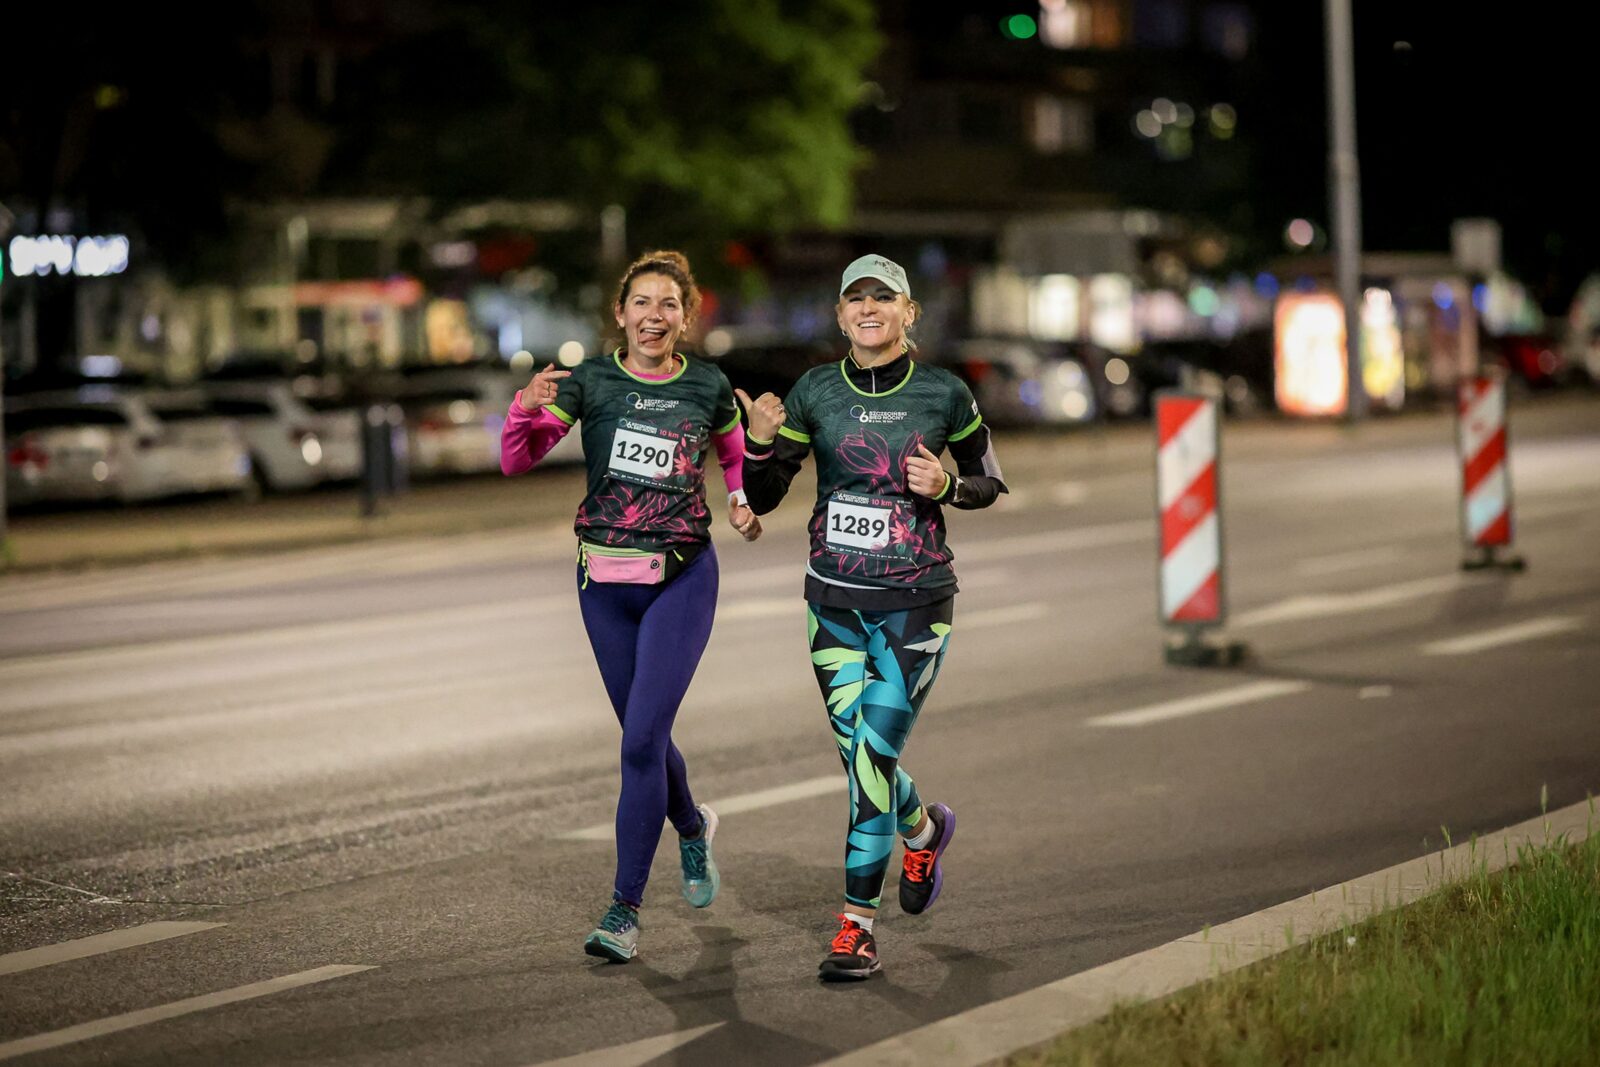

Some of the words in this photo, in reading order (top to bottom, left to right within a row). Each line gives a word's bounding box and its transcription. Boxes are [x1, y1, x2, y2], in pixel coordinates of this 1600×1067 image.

[635, 399, 643, 409] 6
[859, 411, 869, 423] 6
[668, 431, 679, 439] km
[616, 441, 669, 467] 1290
[881, 499, 893, 507] km
[832, 513, 885, 538] 1289
